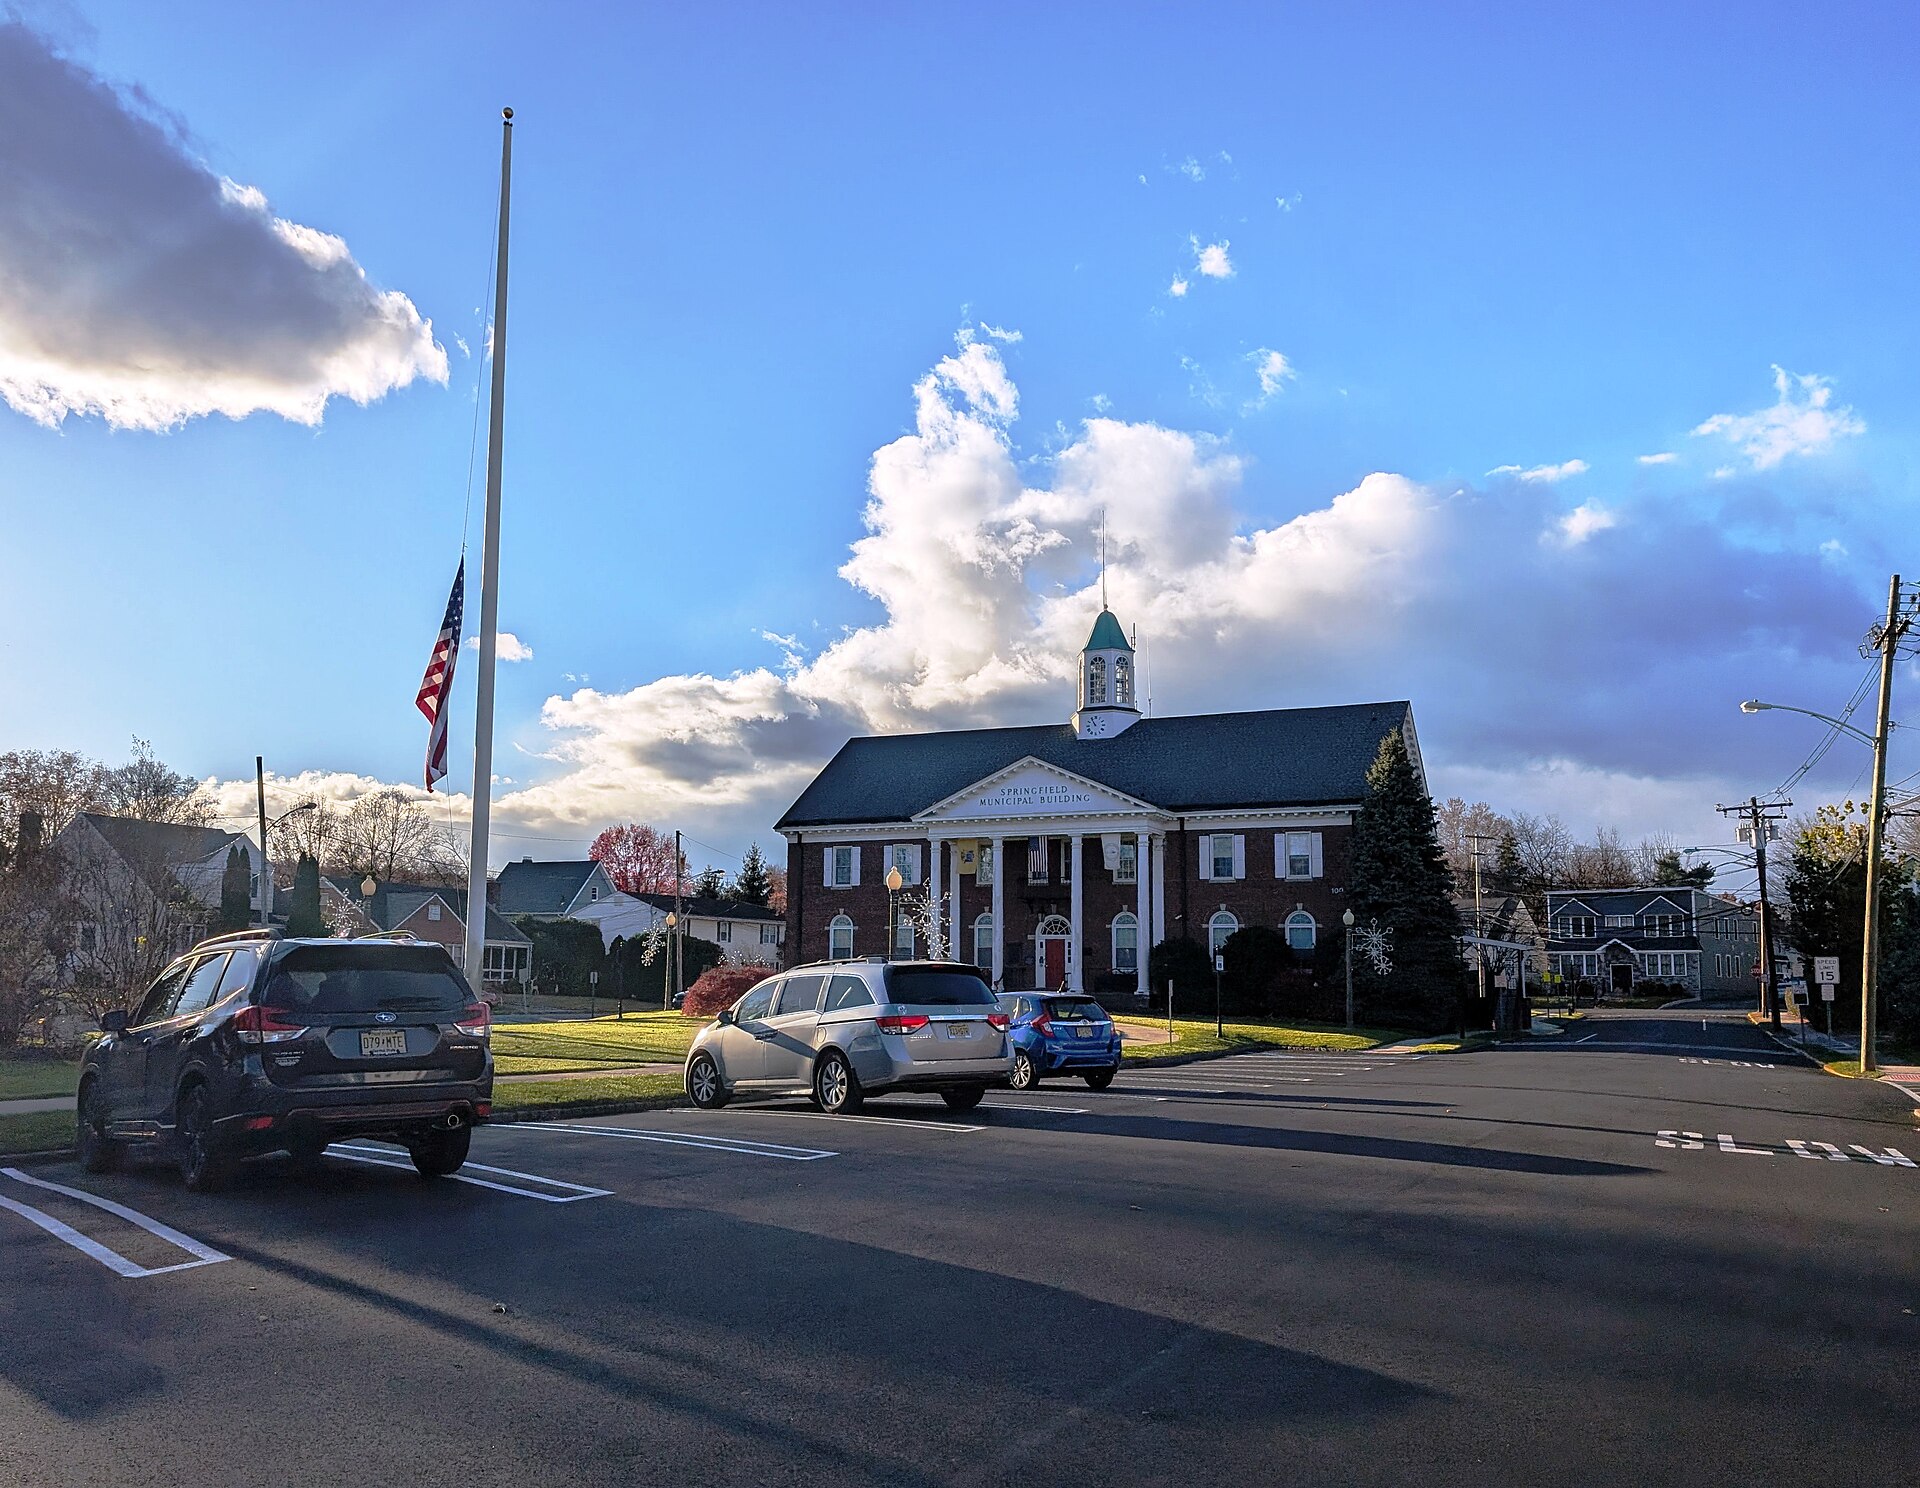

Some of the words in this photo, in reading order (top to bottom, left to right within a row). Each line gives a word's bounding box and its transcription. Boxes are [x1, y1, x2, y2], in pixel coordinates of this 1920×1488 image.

[1000, 785, 1068, 796] SPRINGFIELD
[979, 797, 1034, 806] MUNICIPAL
[1040, 794, 1090, 804] BUILDING
[1820, 971, 1835, 981] 15
[1655, 1130, 1919, 1168] SLOW
